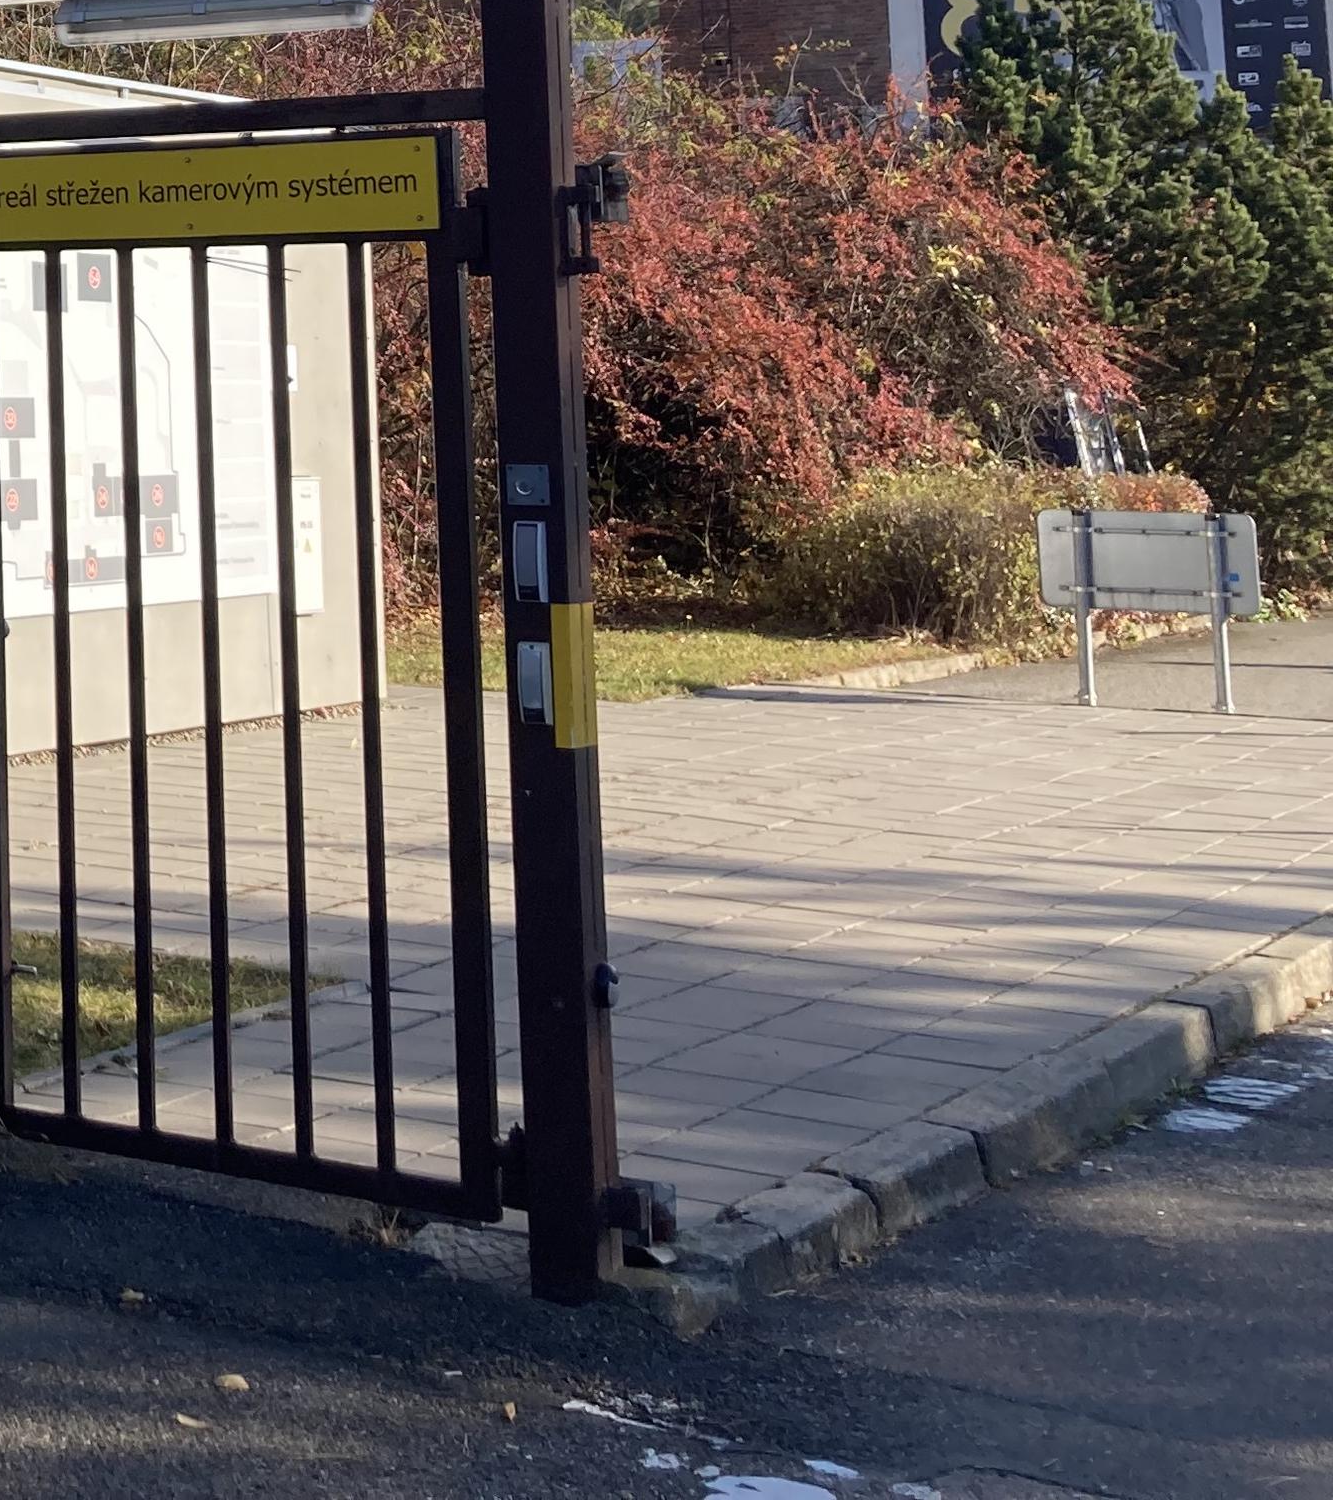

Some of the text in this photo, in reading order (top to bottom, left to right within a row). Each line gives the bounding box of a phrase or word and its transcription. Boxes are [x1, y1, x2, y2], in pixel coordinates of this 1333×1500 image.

[46, 179, 129, 206] střežen
[139, 173, 279, 205] kamerovým
[288, 169, 418, 201] systémem
